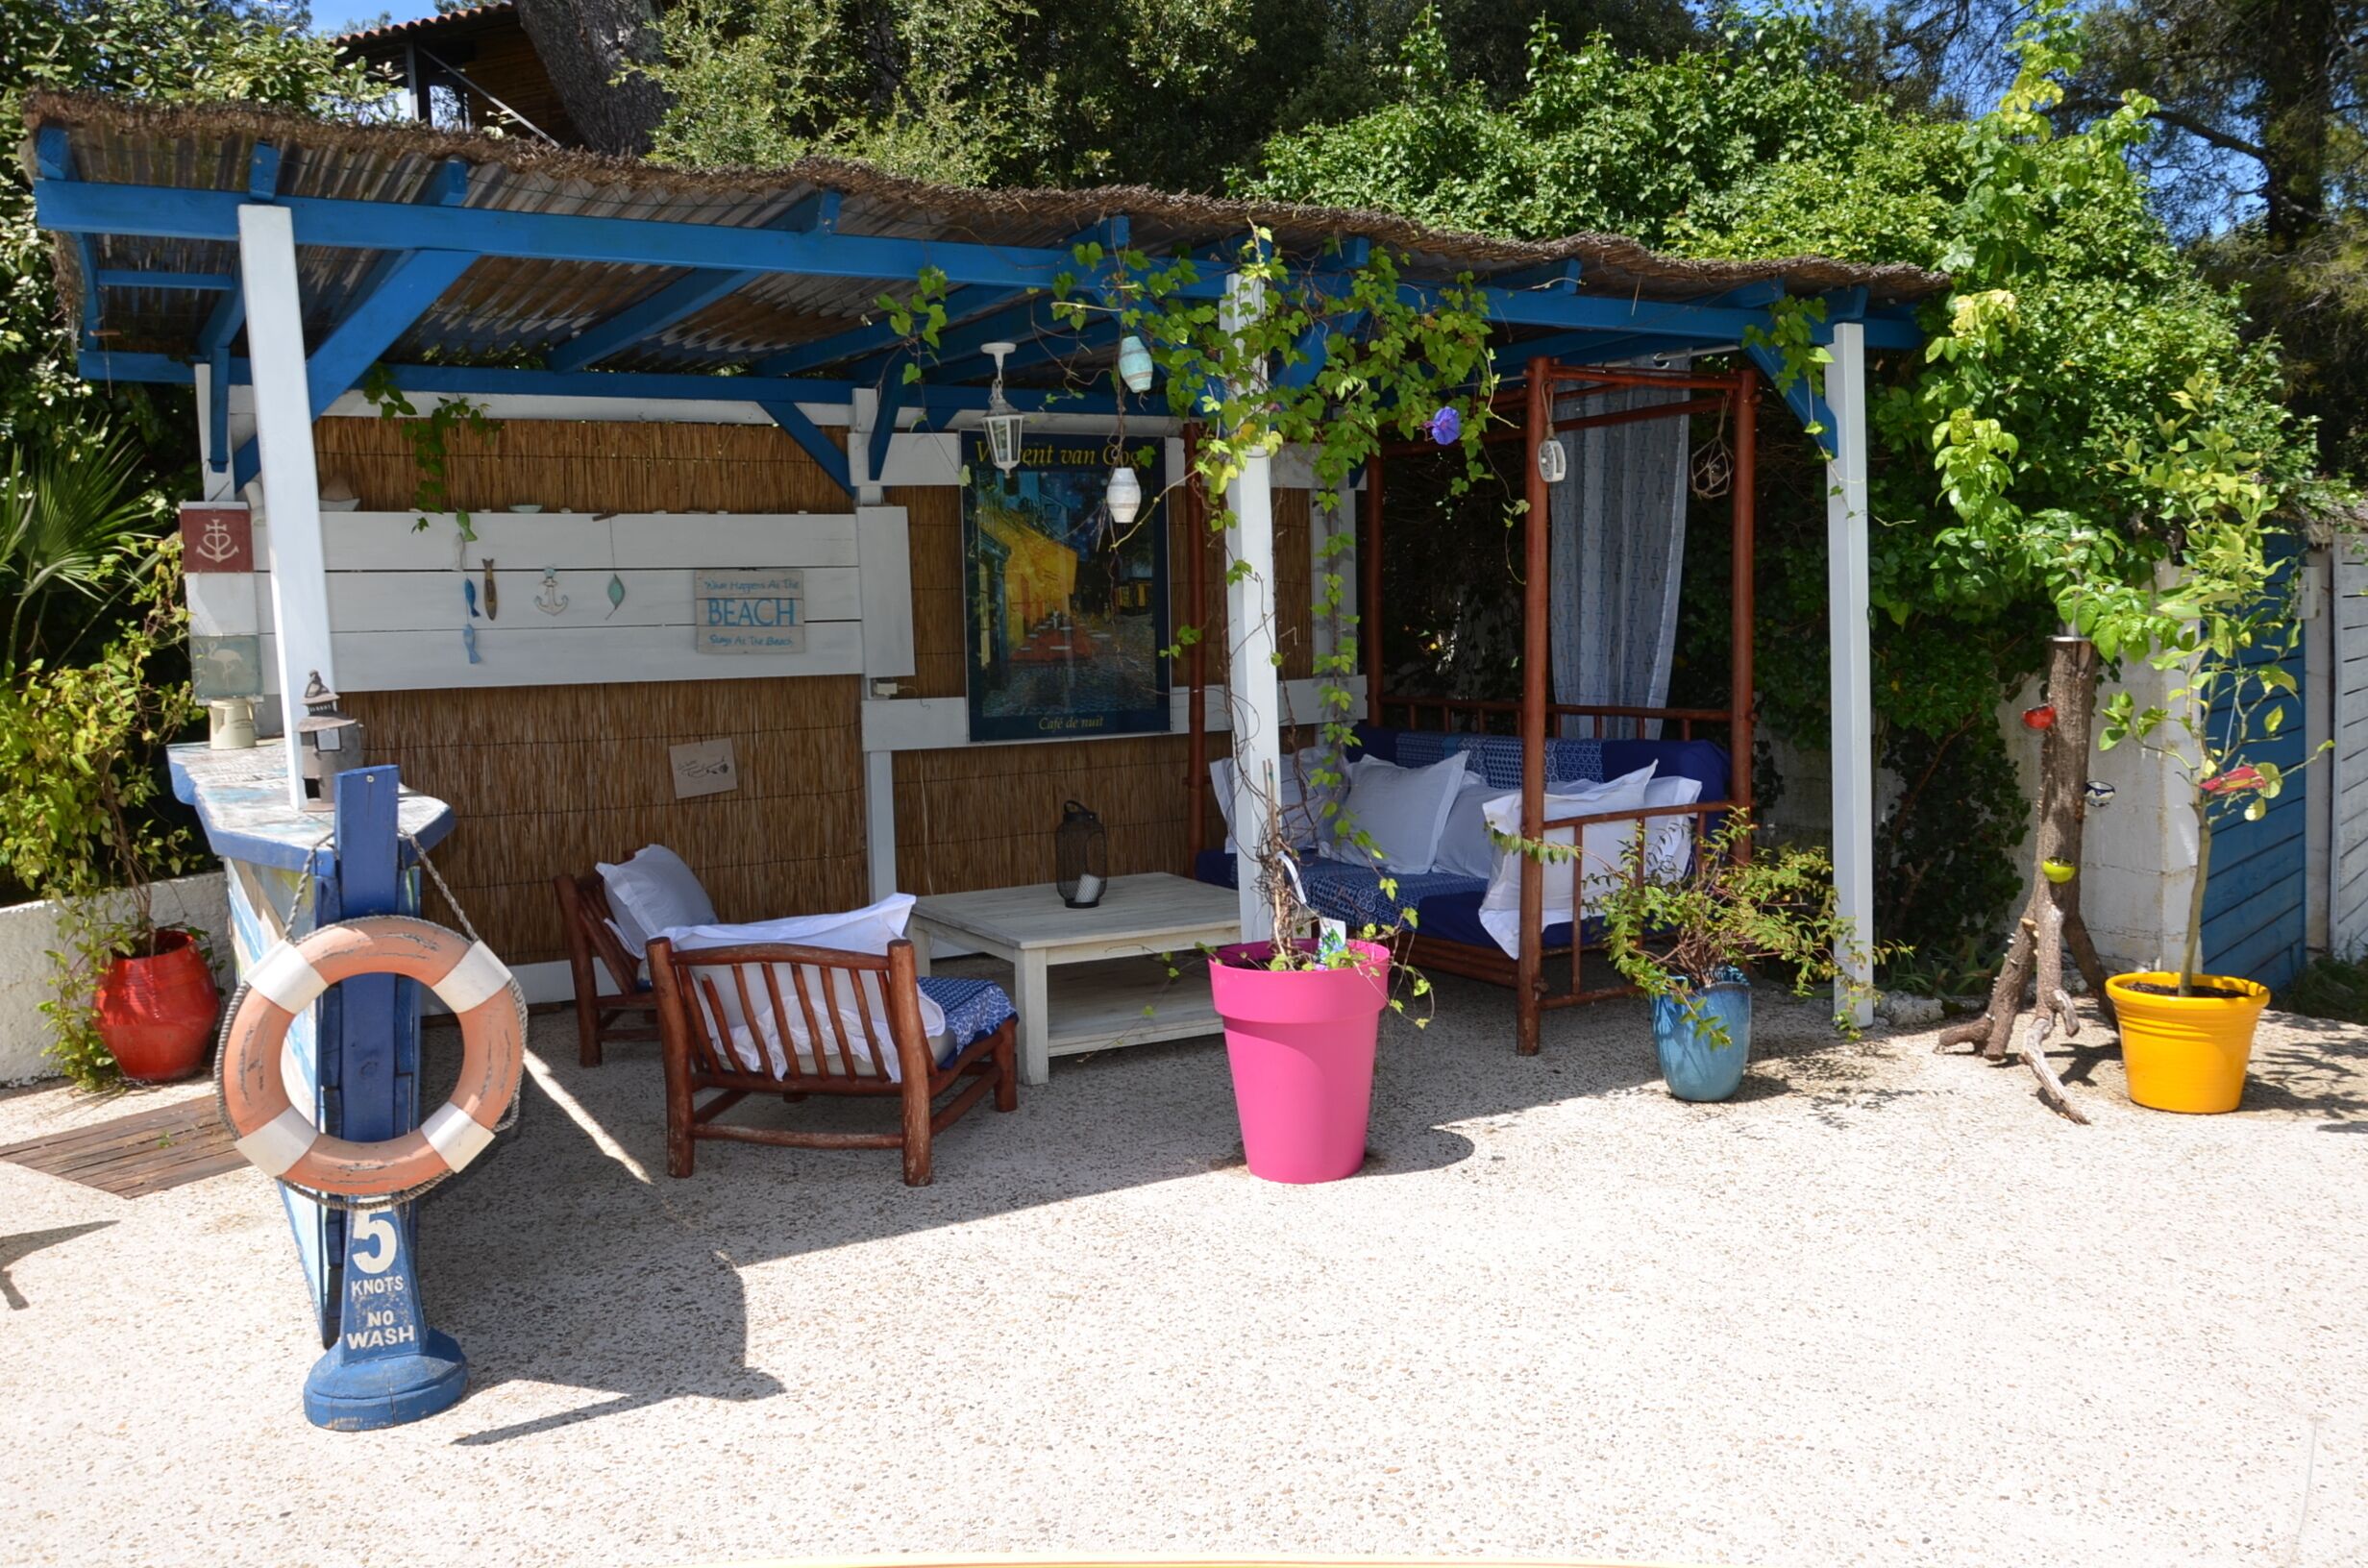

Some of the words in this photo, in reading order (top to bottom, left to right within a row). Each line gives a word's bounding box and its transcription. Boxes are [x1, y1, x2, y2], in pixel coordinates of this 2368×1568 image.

[975, 441, 1054, 464] Vent
[1060, 448, 1096, 465] van
[1103, 445, 1146, 472] Gog
[707, 598, 795, 625] BEACH
[1038, 717, 1063, 731] Café
[1066, 716, 1077, 729] de
[1081, 715, 1104, 728] nuit
[352, 1195, 397, 1274] 5
[351, 1276, 405, 1296] KNOTS
[366, 1310, 395, 1327] NO
[346, 1325, 415, 1350] WASH
